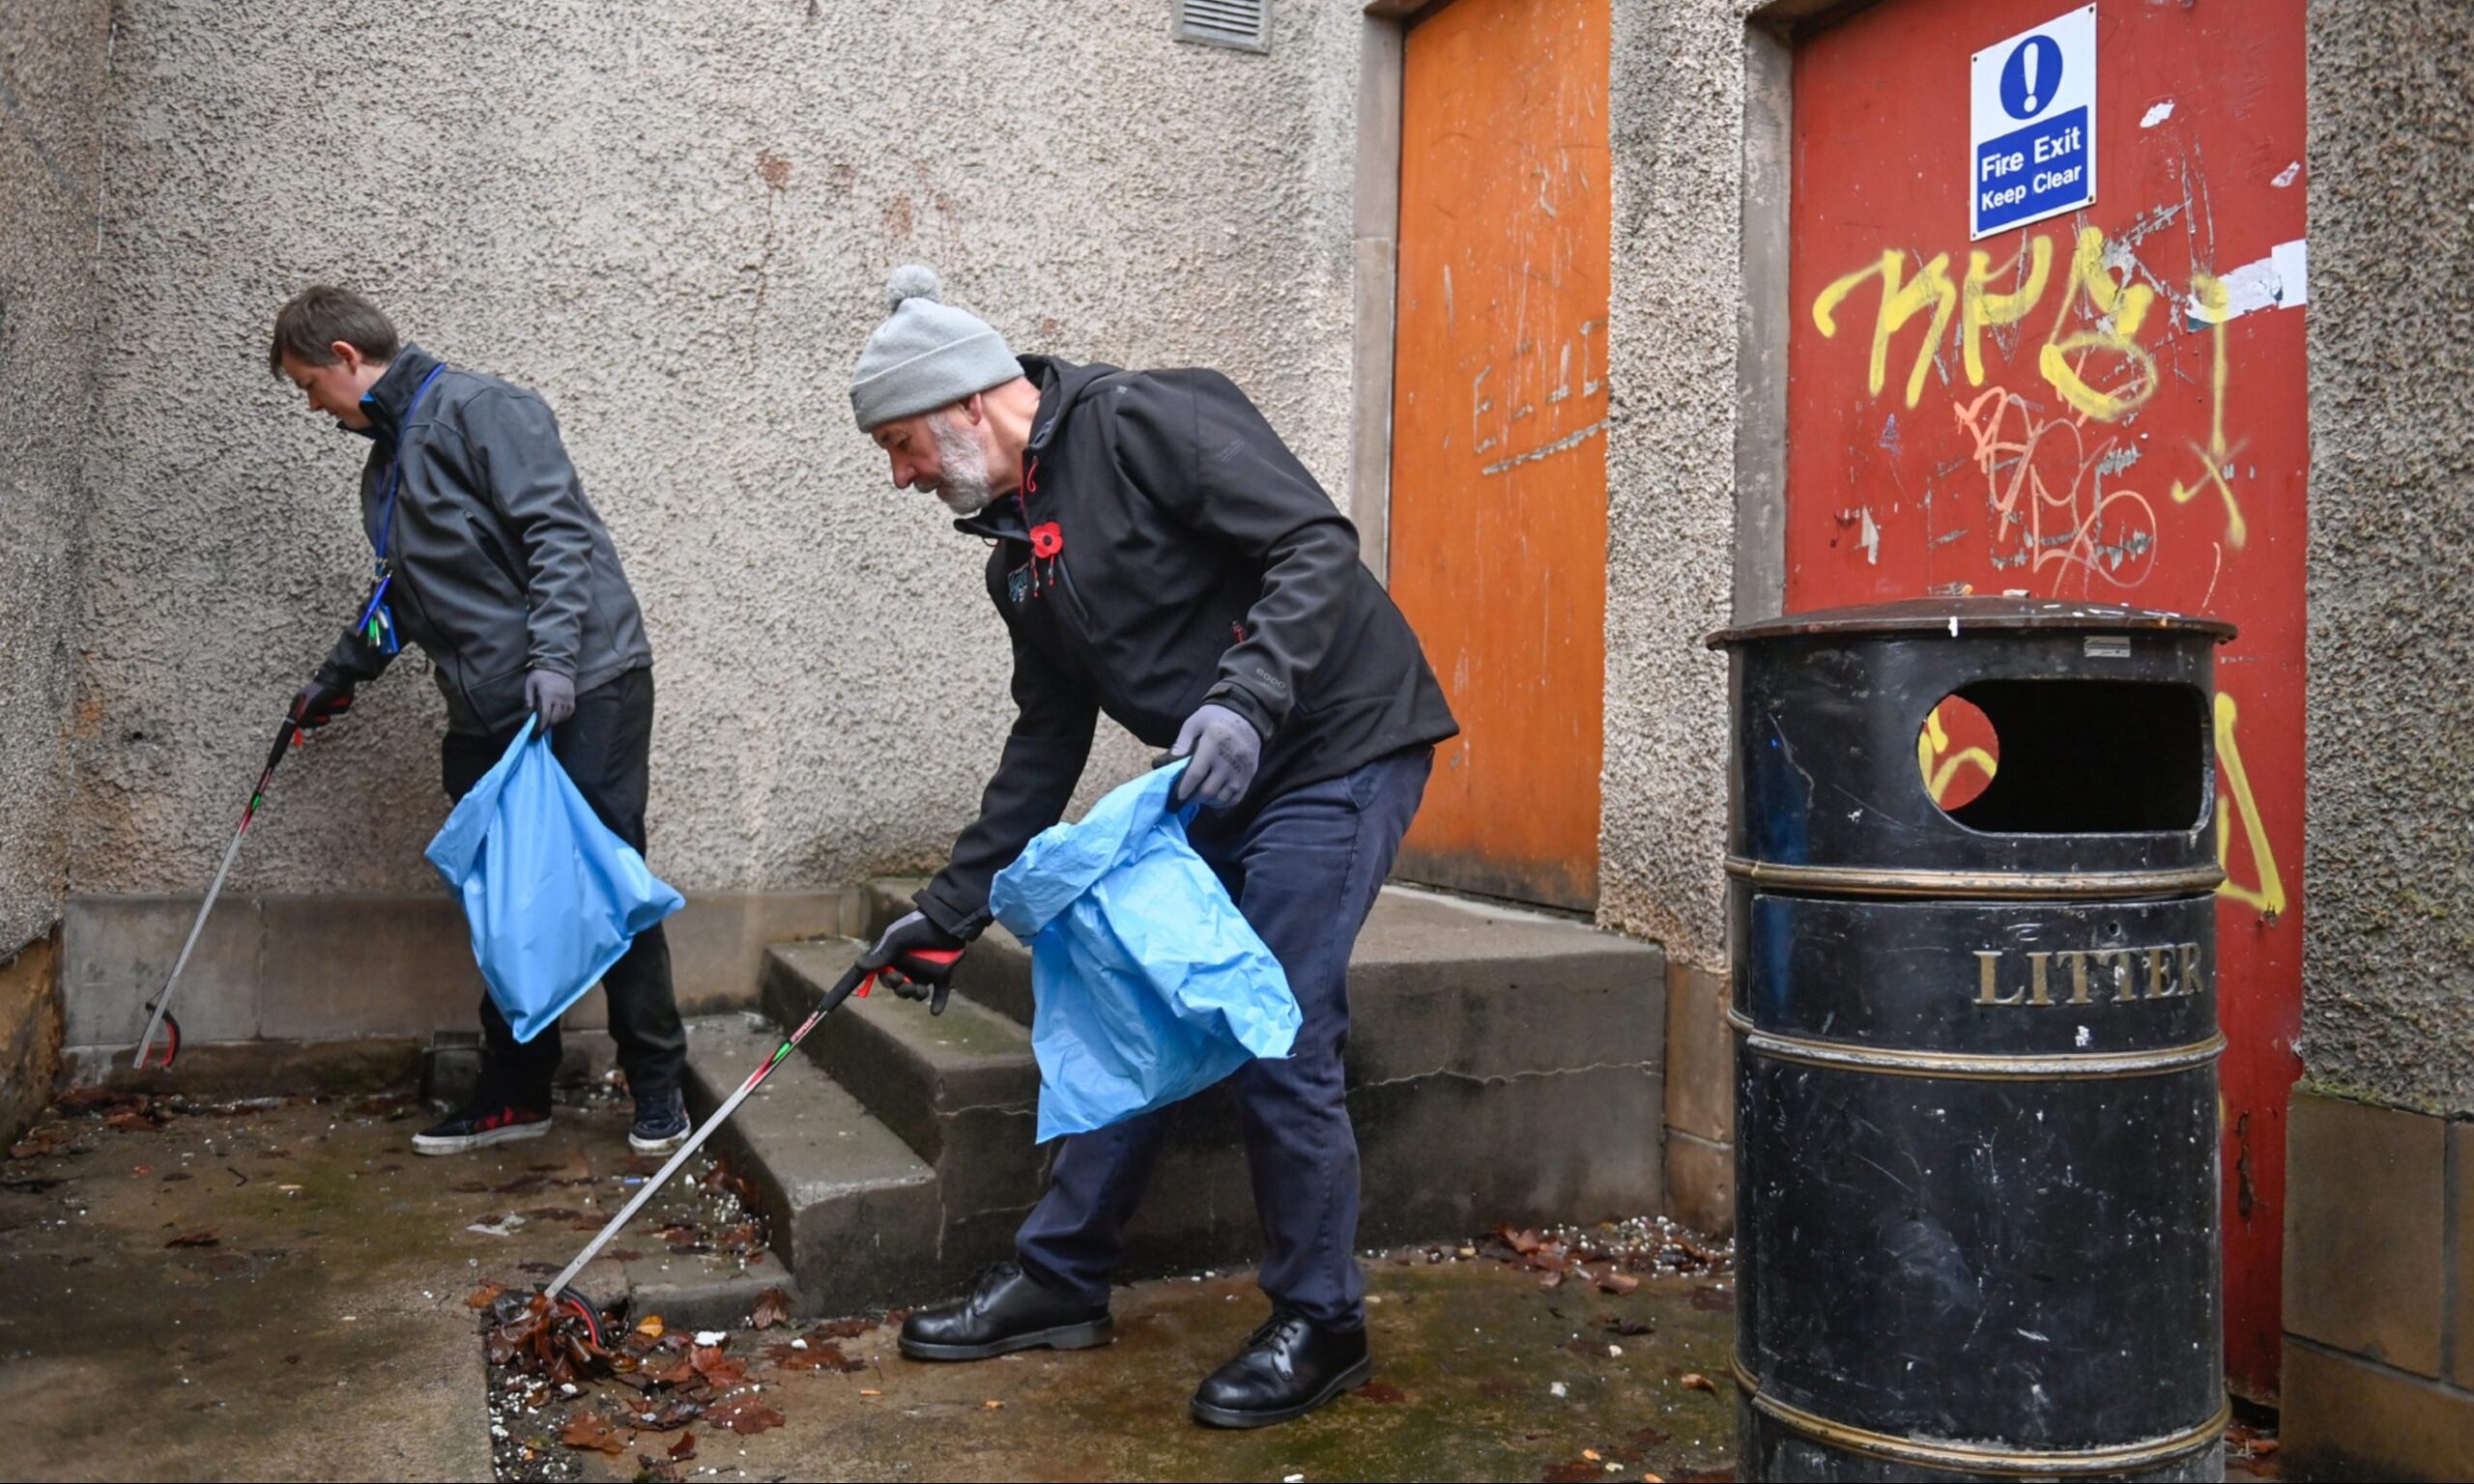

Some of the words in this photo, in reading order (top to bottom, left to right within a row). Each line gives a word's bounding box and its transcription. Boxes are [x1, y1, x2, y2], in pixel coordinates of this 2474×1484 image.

[1981, 152, 2025, 183] Fire
[2033, 126, 2082, 164] Exit
[1981, 185, 2027, 212] Keep
[2032, 165, 2083, 194] Clear
[1971, 942, 2204, 1006] LITTER
